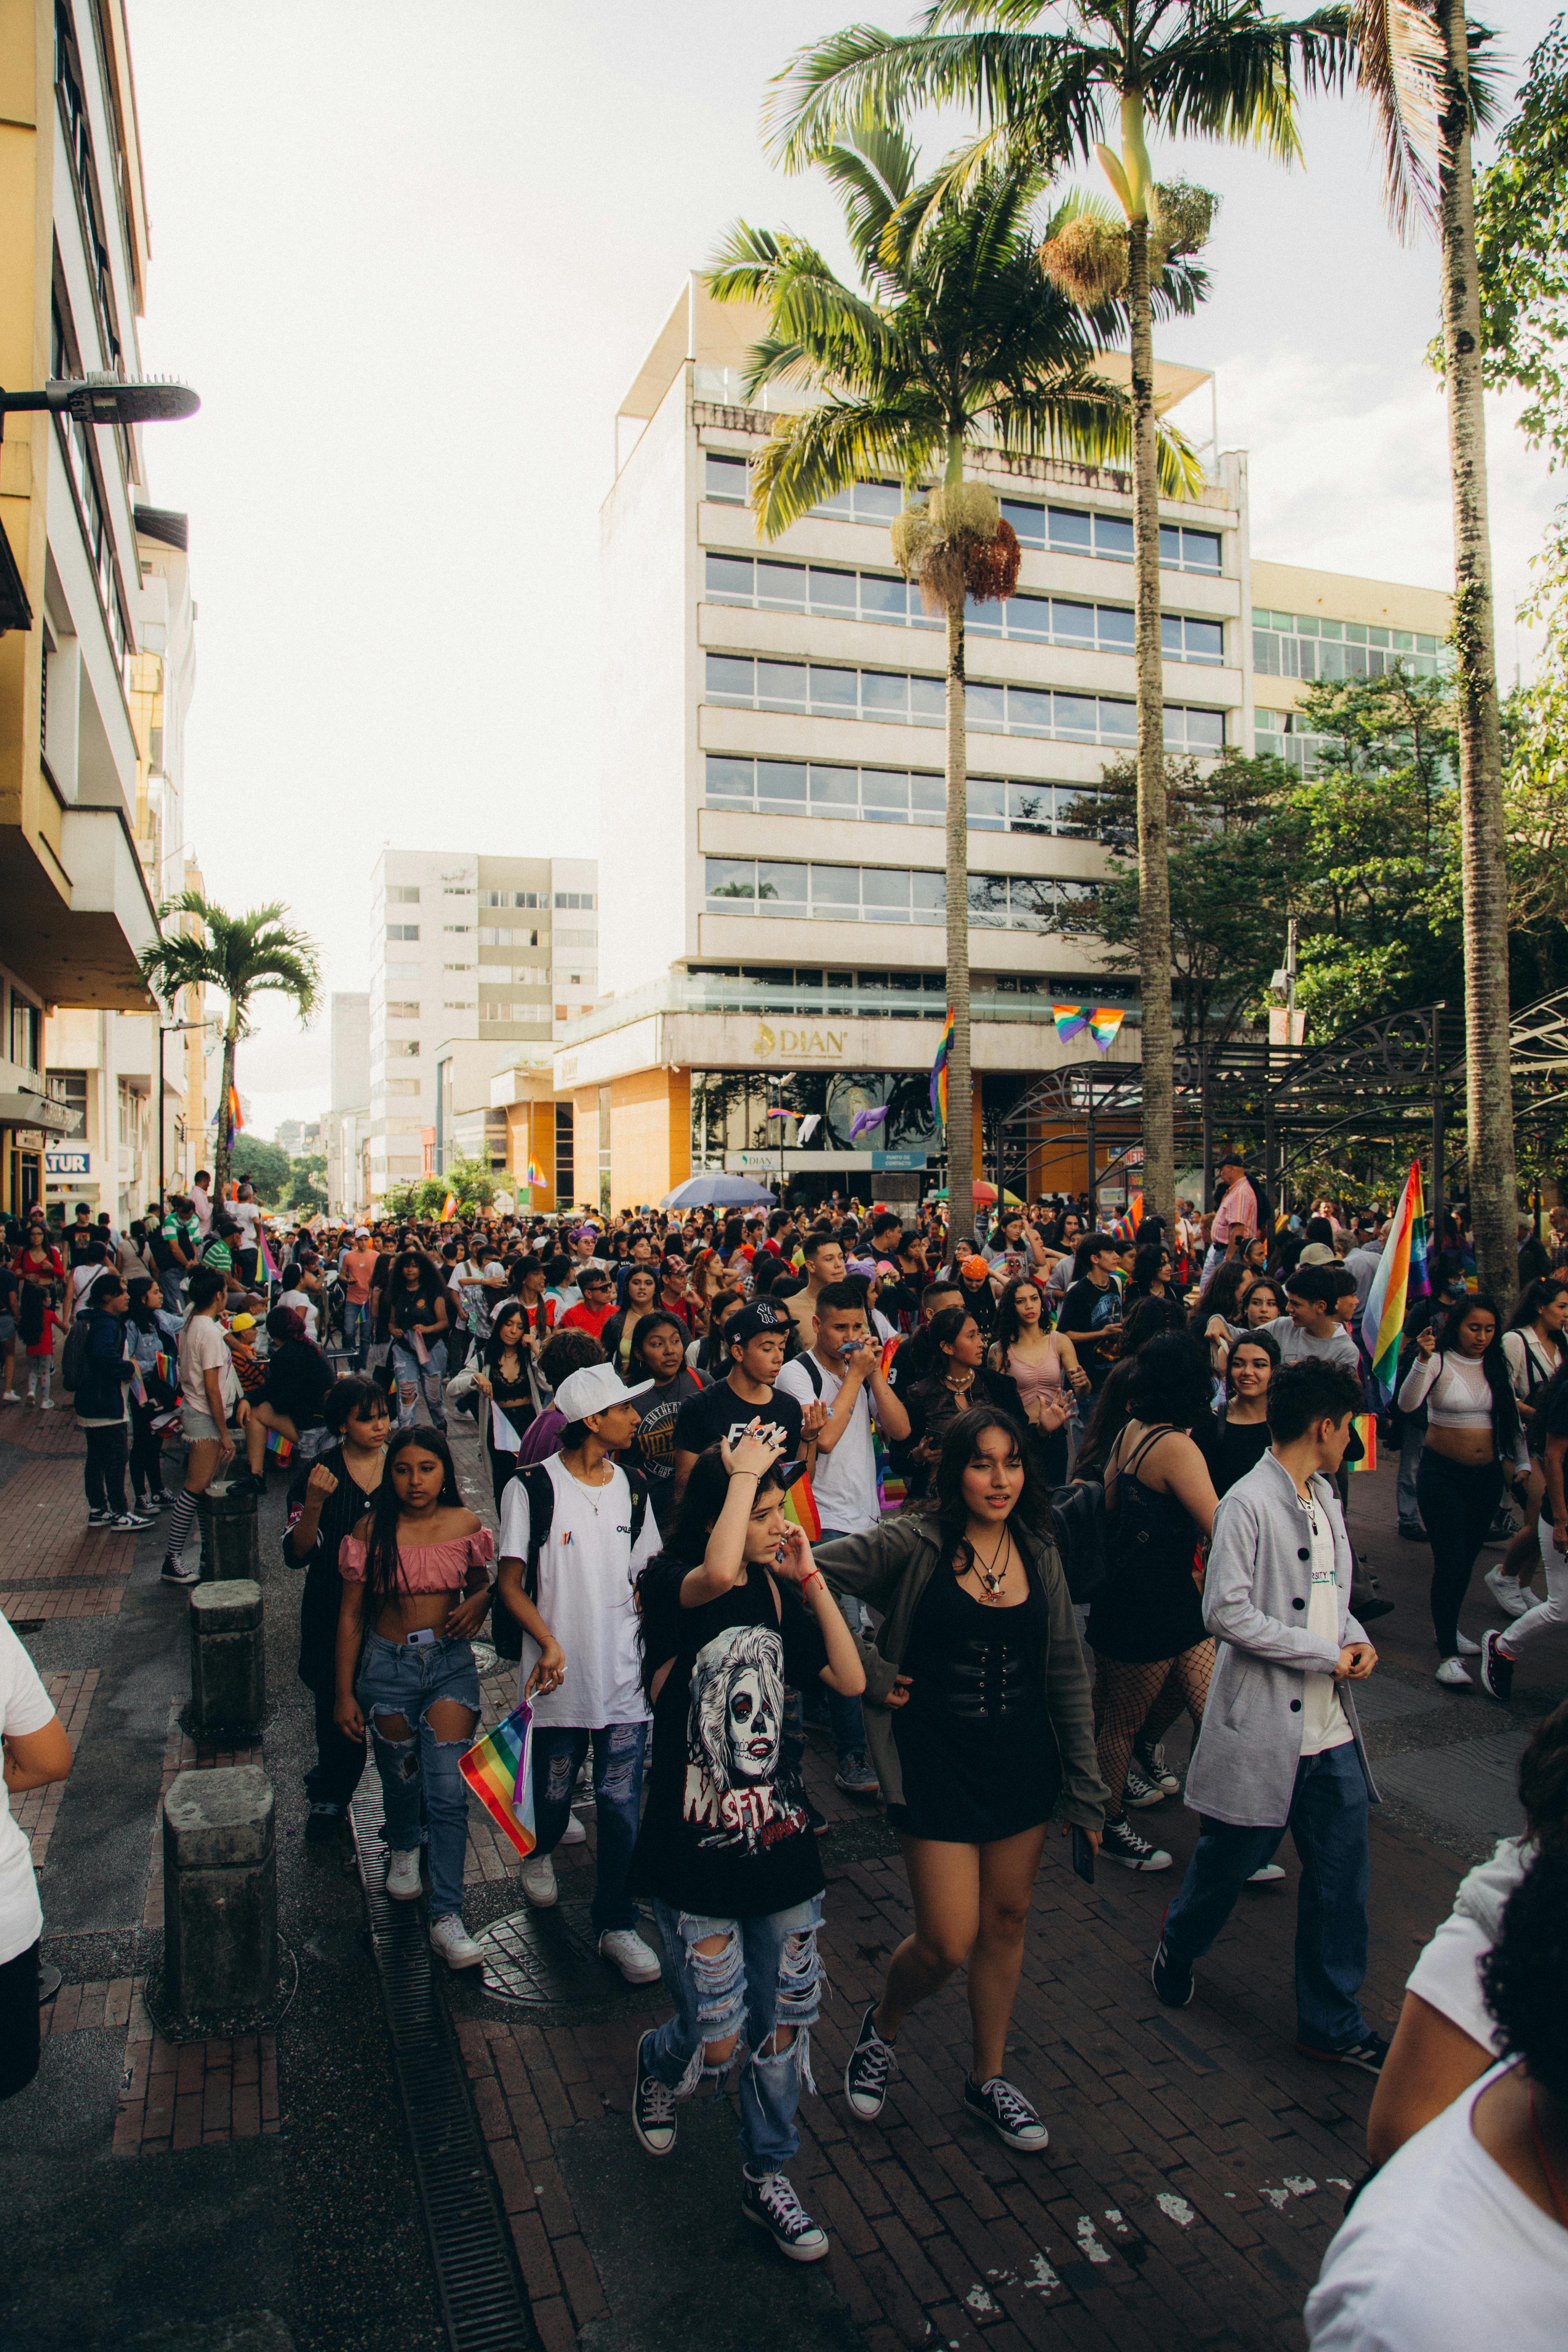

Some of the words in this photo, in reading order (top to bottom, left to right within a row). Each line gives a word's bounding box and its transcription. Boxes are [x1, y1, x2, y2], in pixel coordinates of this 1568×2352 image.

[887, 1368, 897, 1384] 3
[645, 1403, 682, 1425] AUTHEN
[728, 1423, 785, 1448] FX
